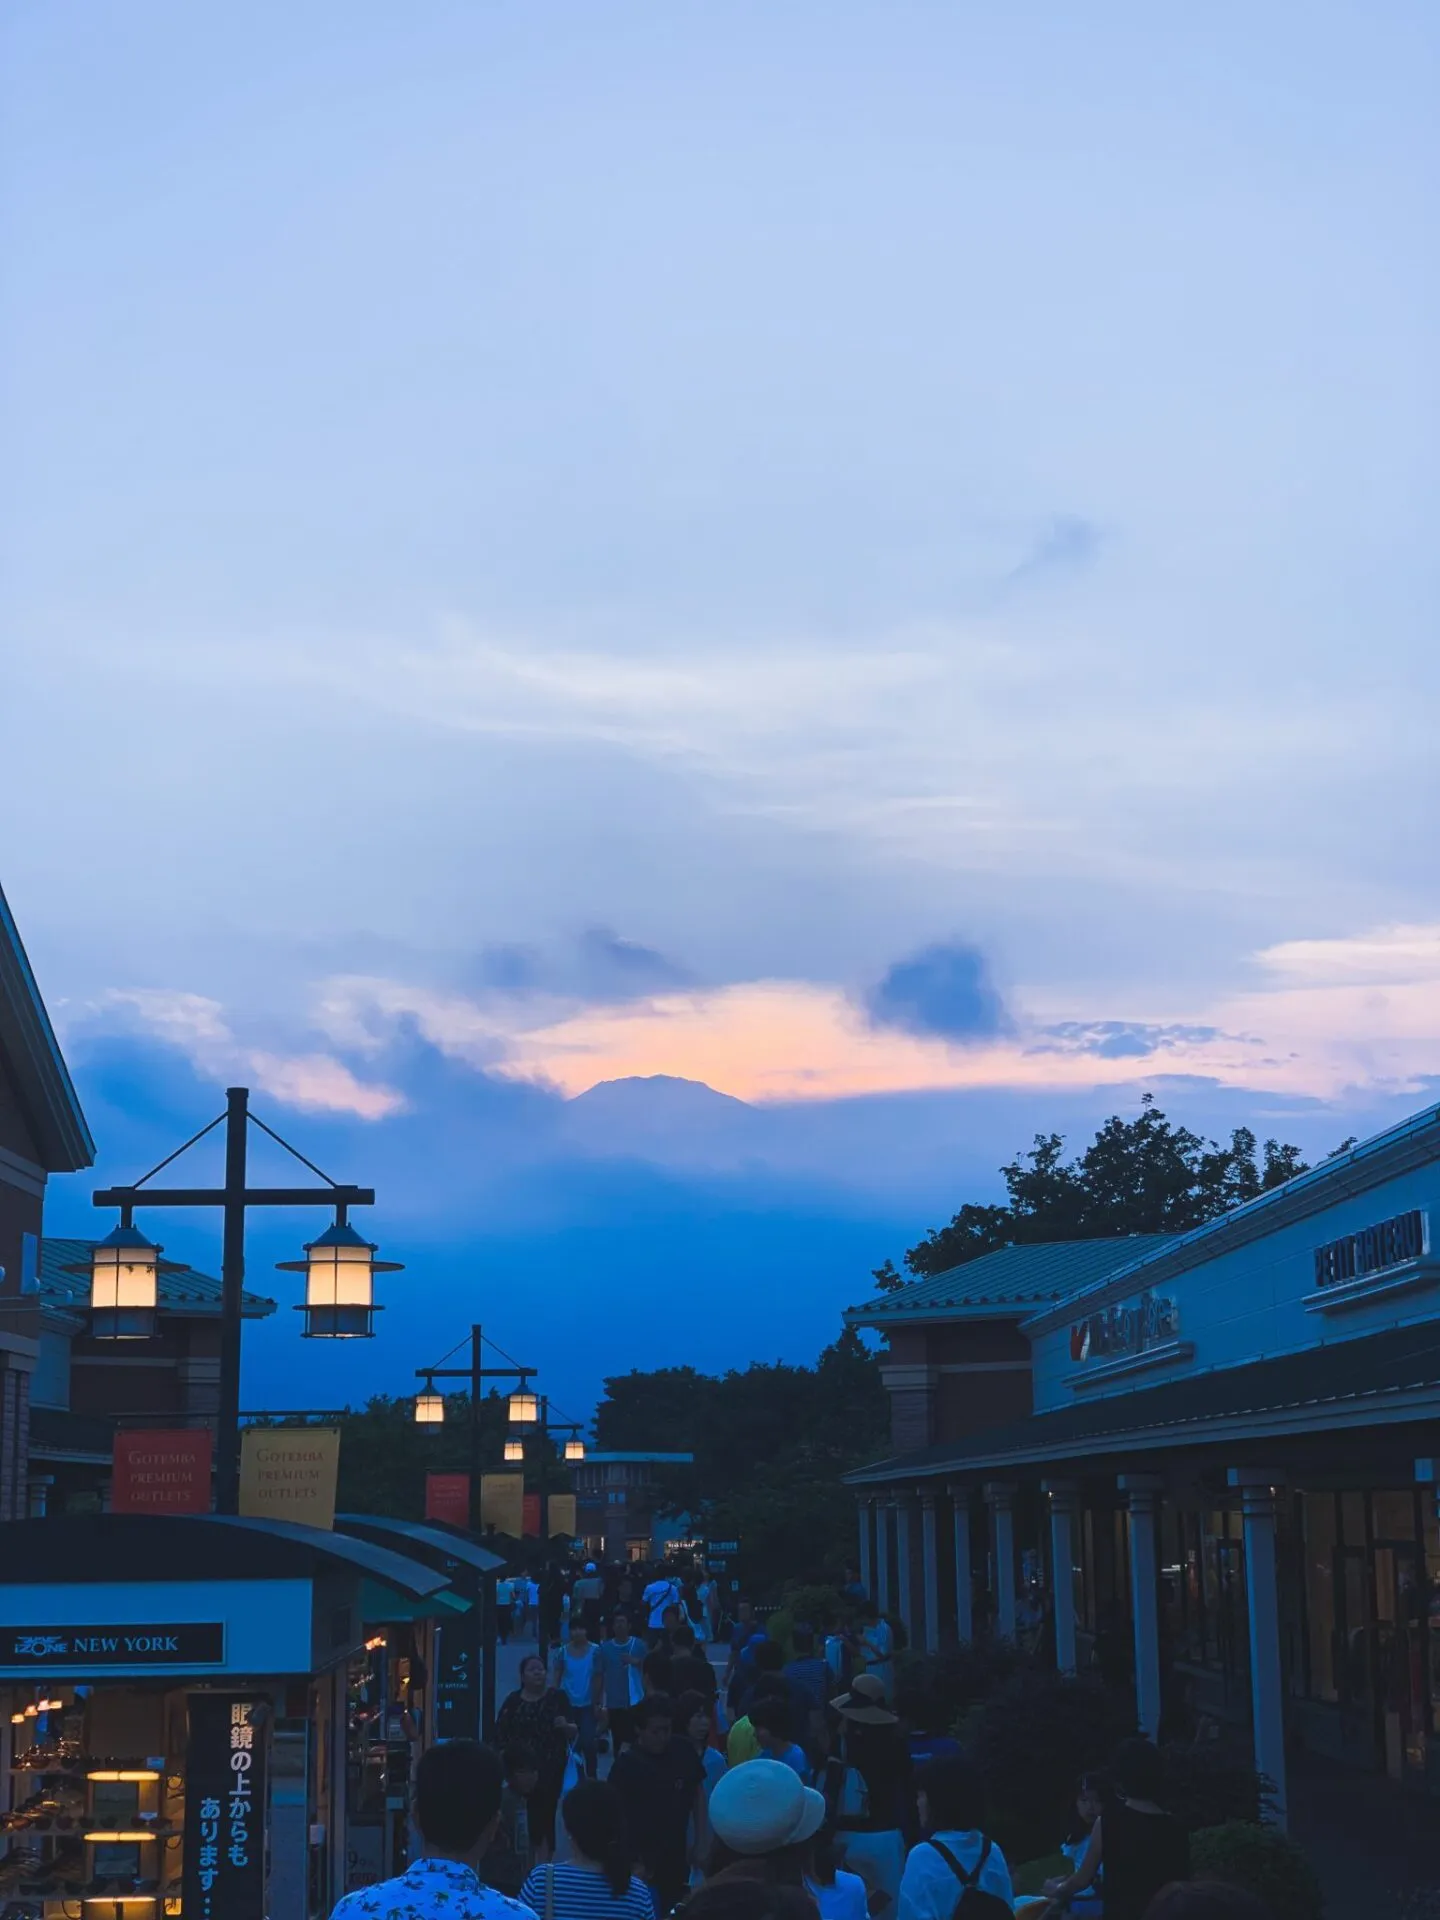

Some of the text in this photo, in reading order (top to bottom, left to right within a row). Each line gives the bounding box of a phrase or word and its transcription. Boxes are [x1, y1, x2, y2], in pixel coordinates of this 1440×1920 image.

[130, 1472, 192, 1483] PREMIUM
[258, 1469, 319, 1481] PREMIUM
[131, 1491, 191, 1502] OUTLETS
[258, 1488, 317, 1499] OUTLETS
[73, 1638, 118, 1652] NEW
[124, 1636, 178, 1651] YORK
[229, 1703, 253, 1867] 眼鏡の上からも
